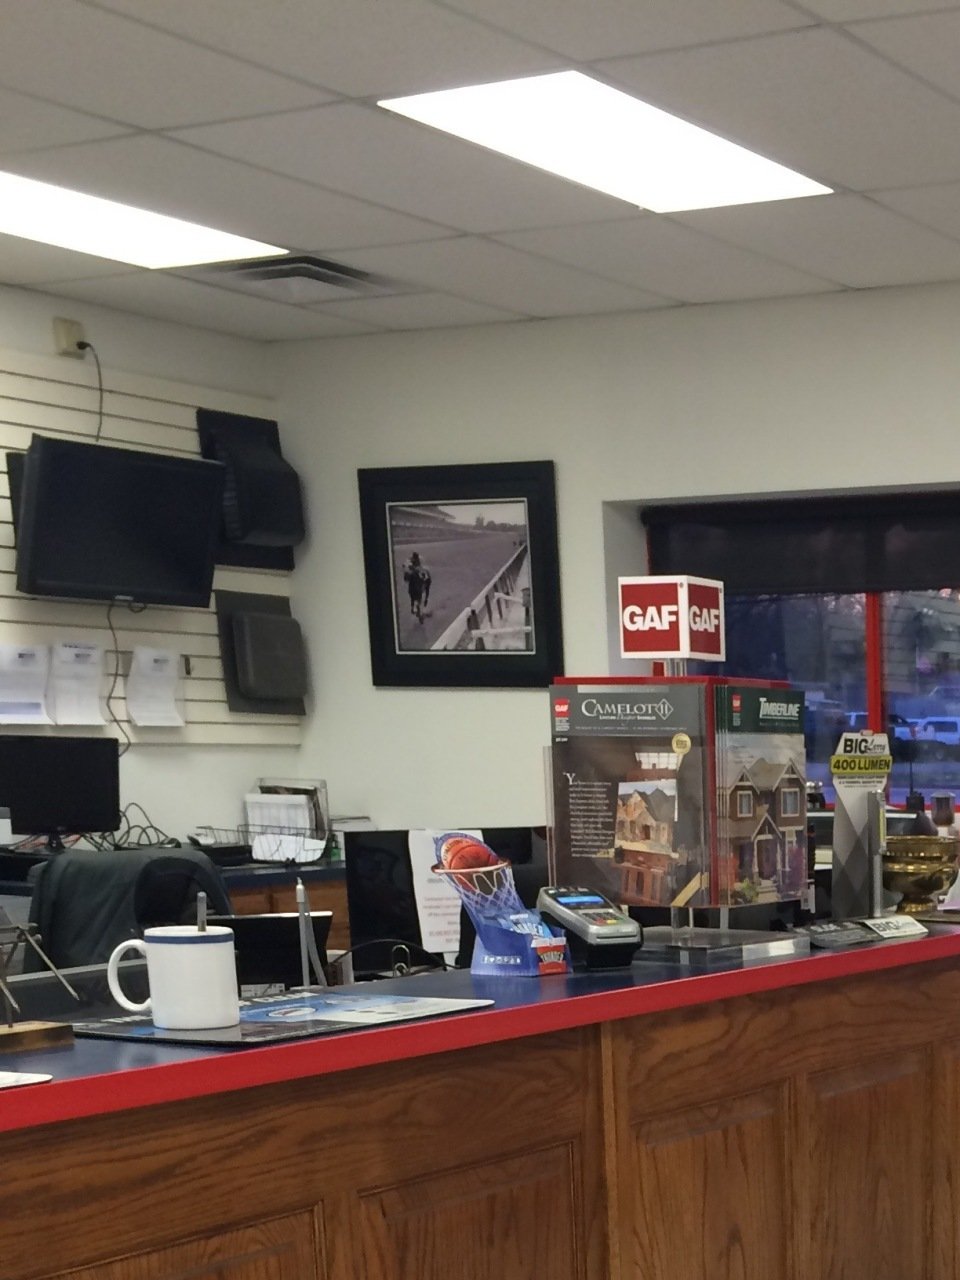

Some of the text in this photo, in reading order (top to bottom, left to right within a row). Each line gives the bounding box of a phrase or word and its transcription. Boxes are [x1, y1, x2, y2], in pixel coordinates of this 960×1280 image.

[623, 605, 678, 631] GAF
[689, 606, 720, 633] GAF
[581, 699, 657, 717] CAMELOT
[844, 738, 868, 754] BIG
[833, 759, 890, 770] 400 LUMEN
